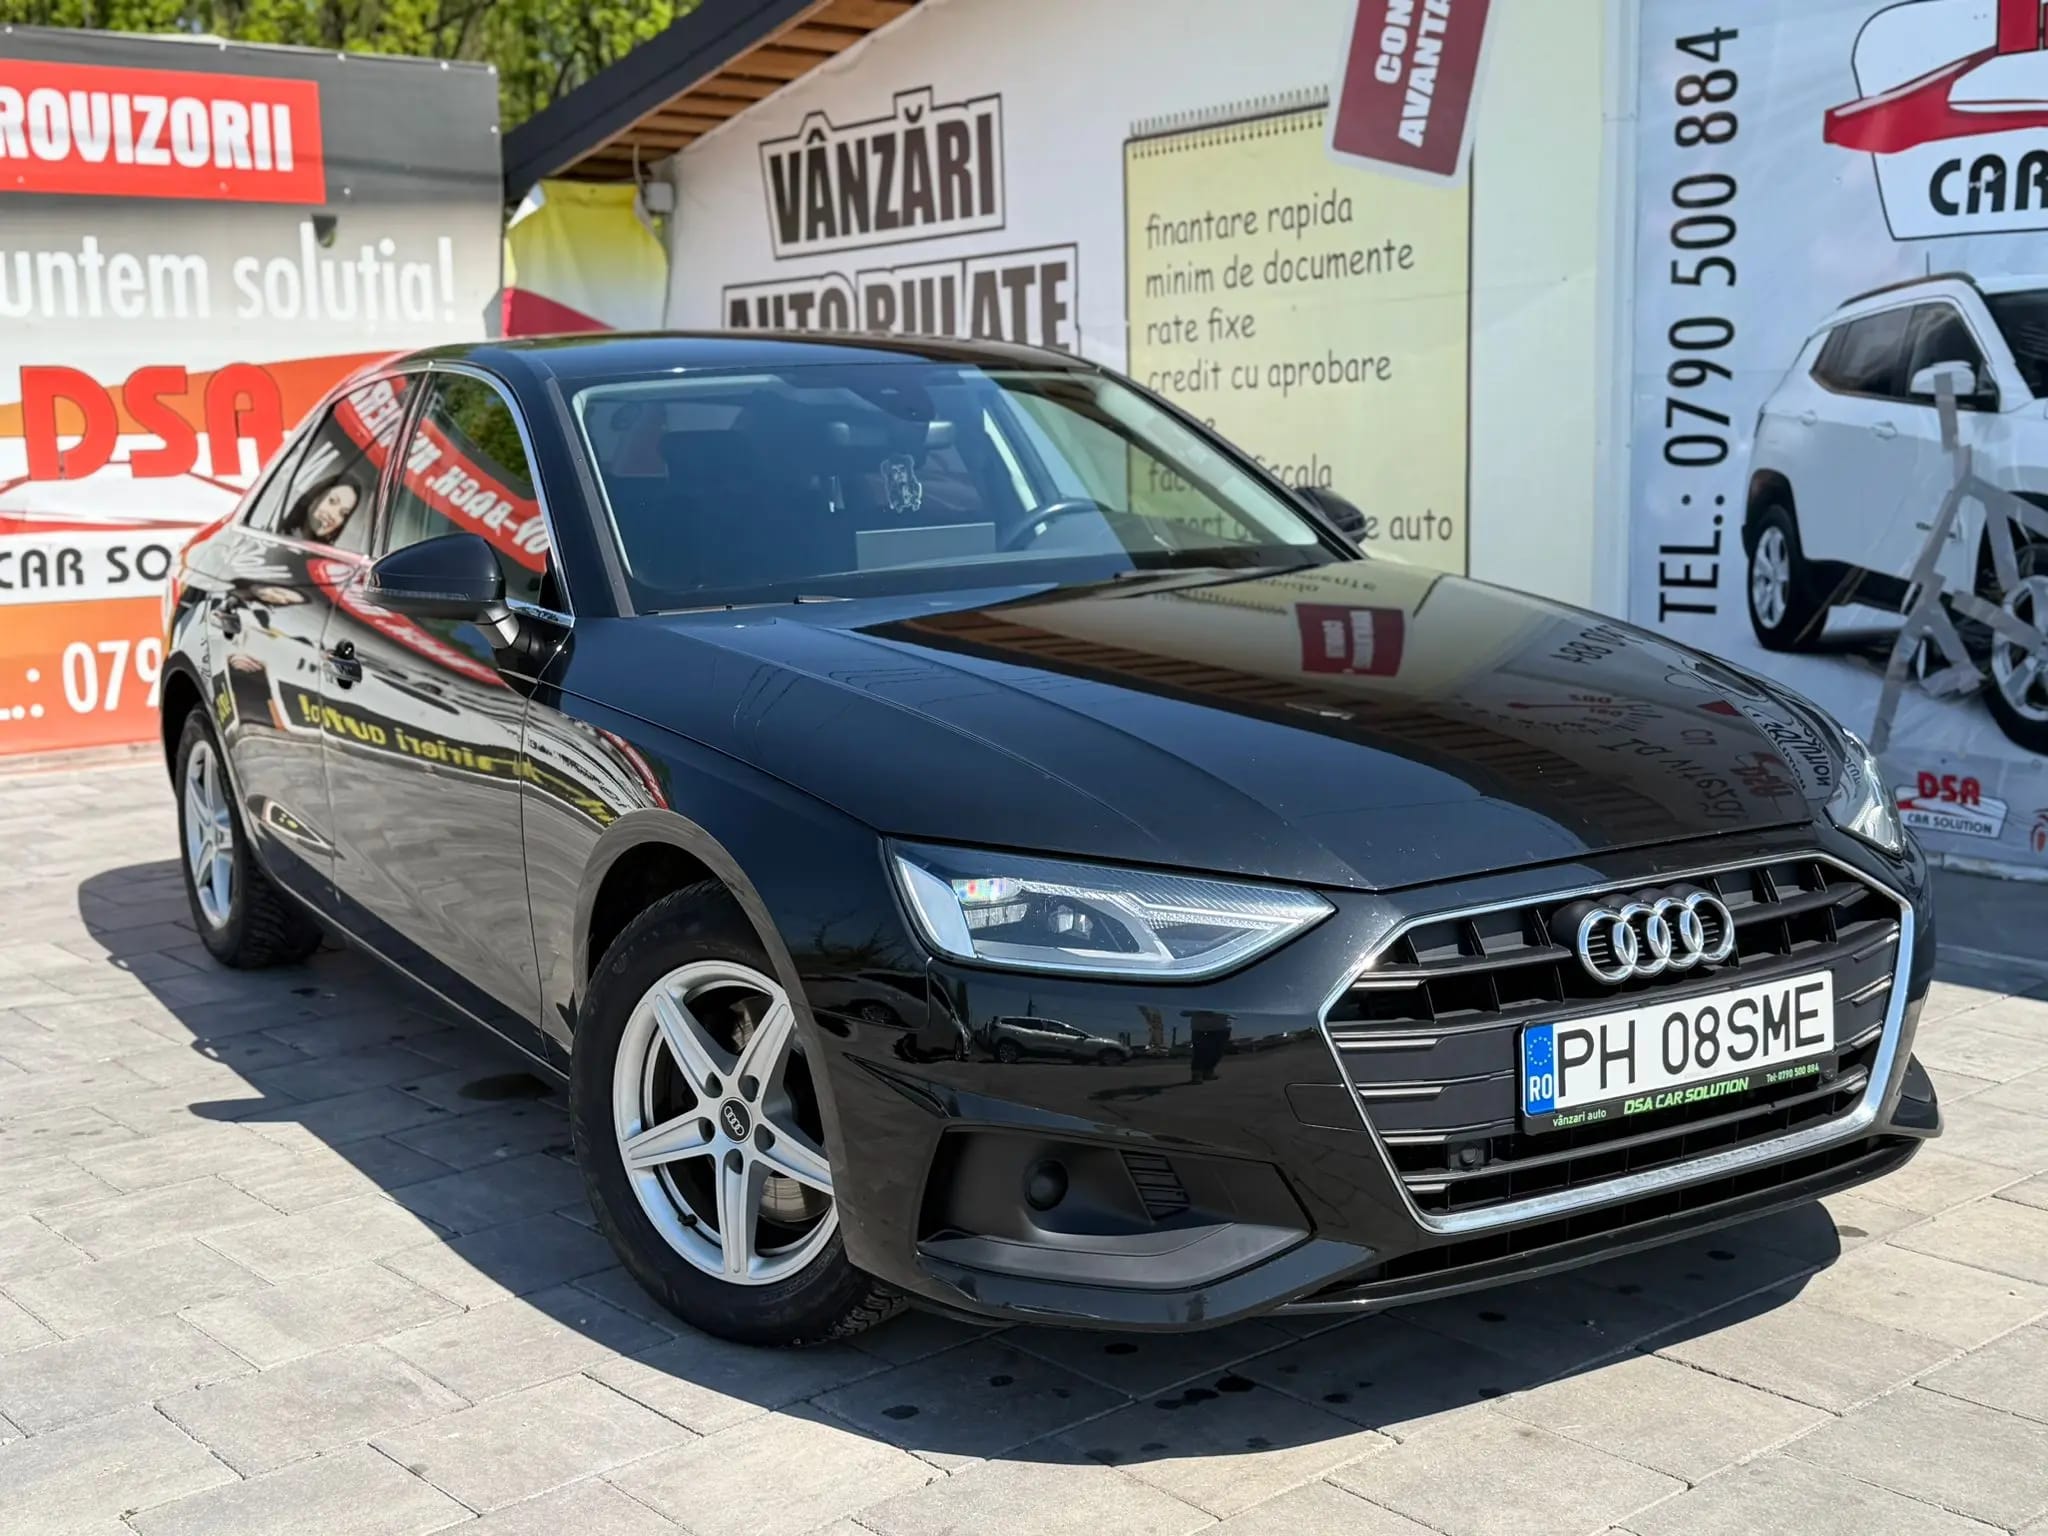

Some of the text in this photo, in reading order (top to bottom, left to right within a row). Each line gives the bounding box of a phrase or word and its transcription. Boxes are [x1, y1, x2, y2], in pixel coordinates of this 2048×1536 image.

[769, 104, 996, 245] VÂNZĂRI
[1928, 148, 2048, 216] CAR
[1146, 188, 1353, 250] finantare rapida
[1146, 239, 1415, 298] minim de documente
[1147, 307, 1256, 346] rate fixe
[1659, 27, 1739, 622] TEL.: 0790 500 884
[1150, 349, 1393, 398] credit cu aprobare
[20, 362, 285, 480] DSA
[1389, 507, 1453, 541] auto
[1917, 770, 1981, 806] DSA
[1907, 813, 1993, 834] CAR SOLUTION
[1557, 1020, 1636, 1098] PH
[1778, 1069, 1794, 1081] 0790
[1794, 1065, 1807, 1077] 500
[1807, 1062, 1819, 1074] 884
[1529, 1073, 1553, 1102] RO
[1623, 1077, 1749, 1115] DSA CAR SOLUTION
[1552, 1107, 1607, 1128] vânzari auto
